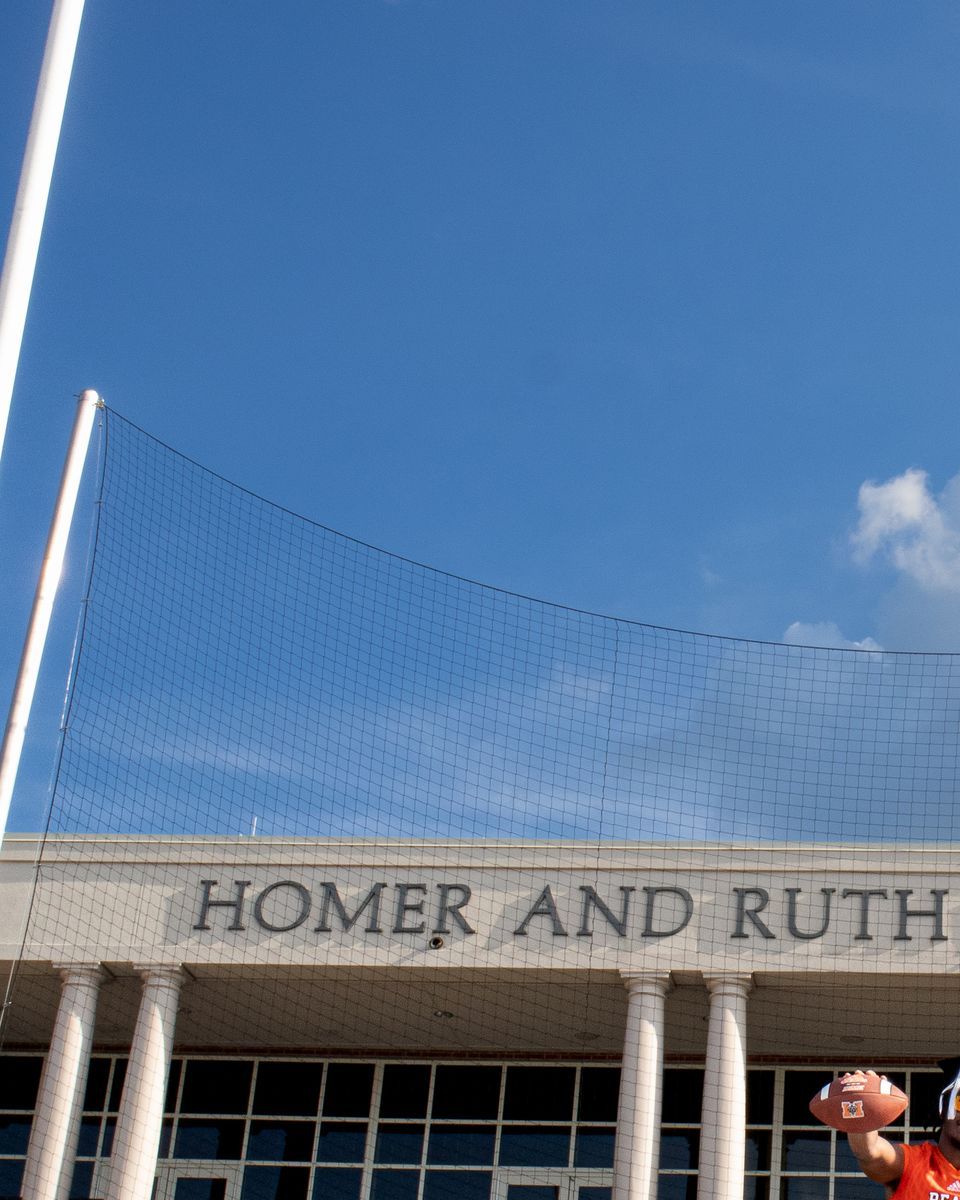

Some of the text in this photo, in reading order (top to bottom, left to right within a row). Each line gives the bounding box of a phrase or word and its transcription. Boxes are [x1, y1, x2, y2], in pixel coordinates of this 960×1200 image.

[192, 879, 476, 935] HOMER
[514, 883, 694, 938] AND
[730, 886, 949, 941] RUTH
